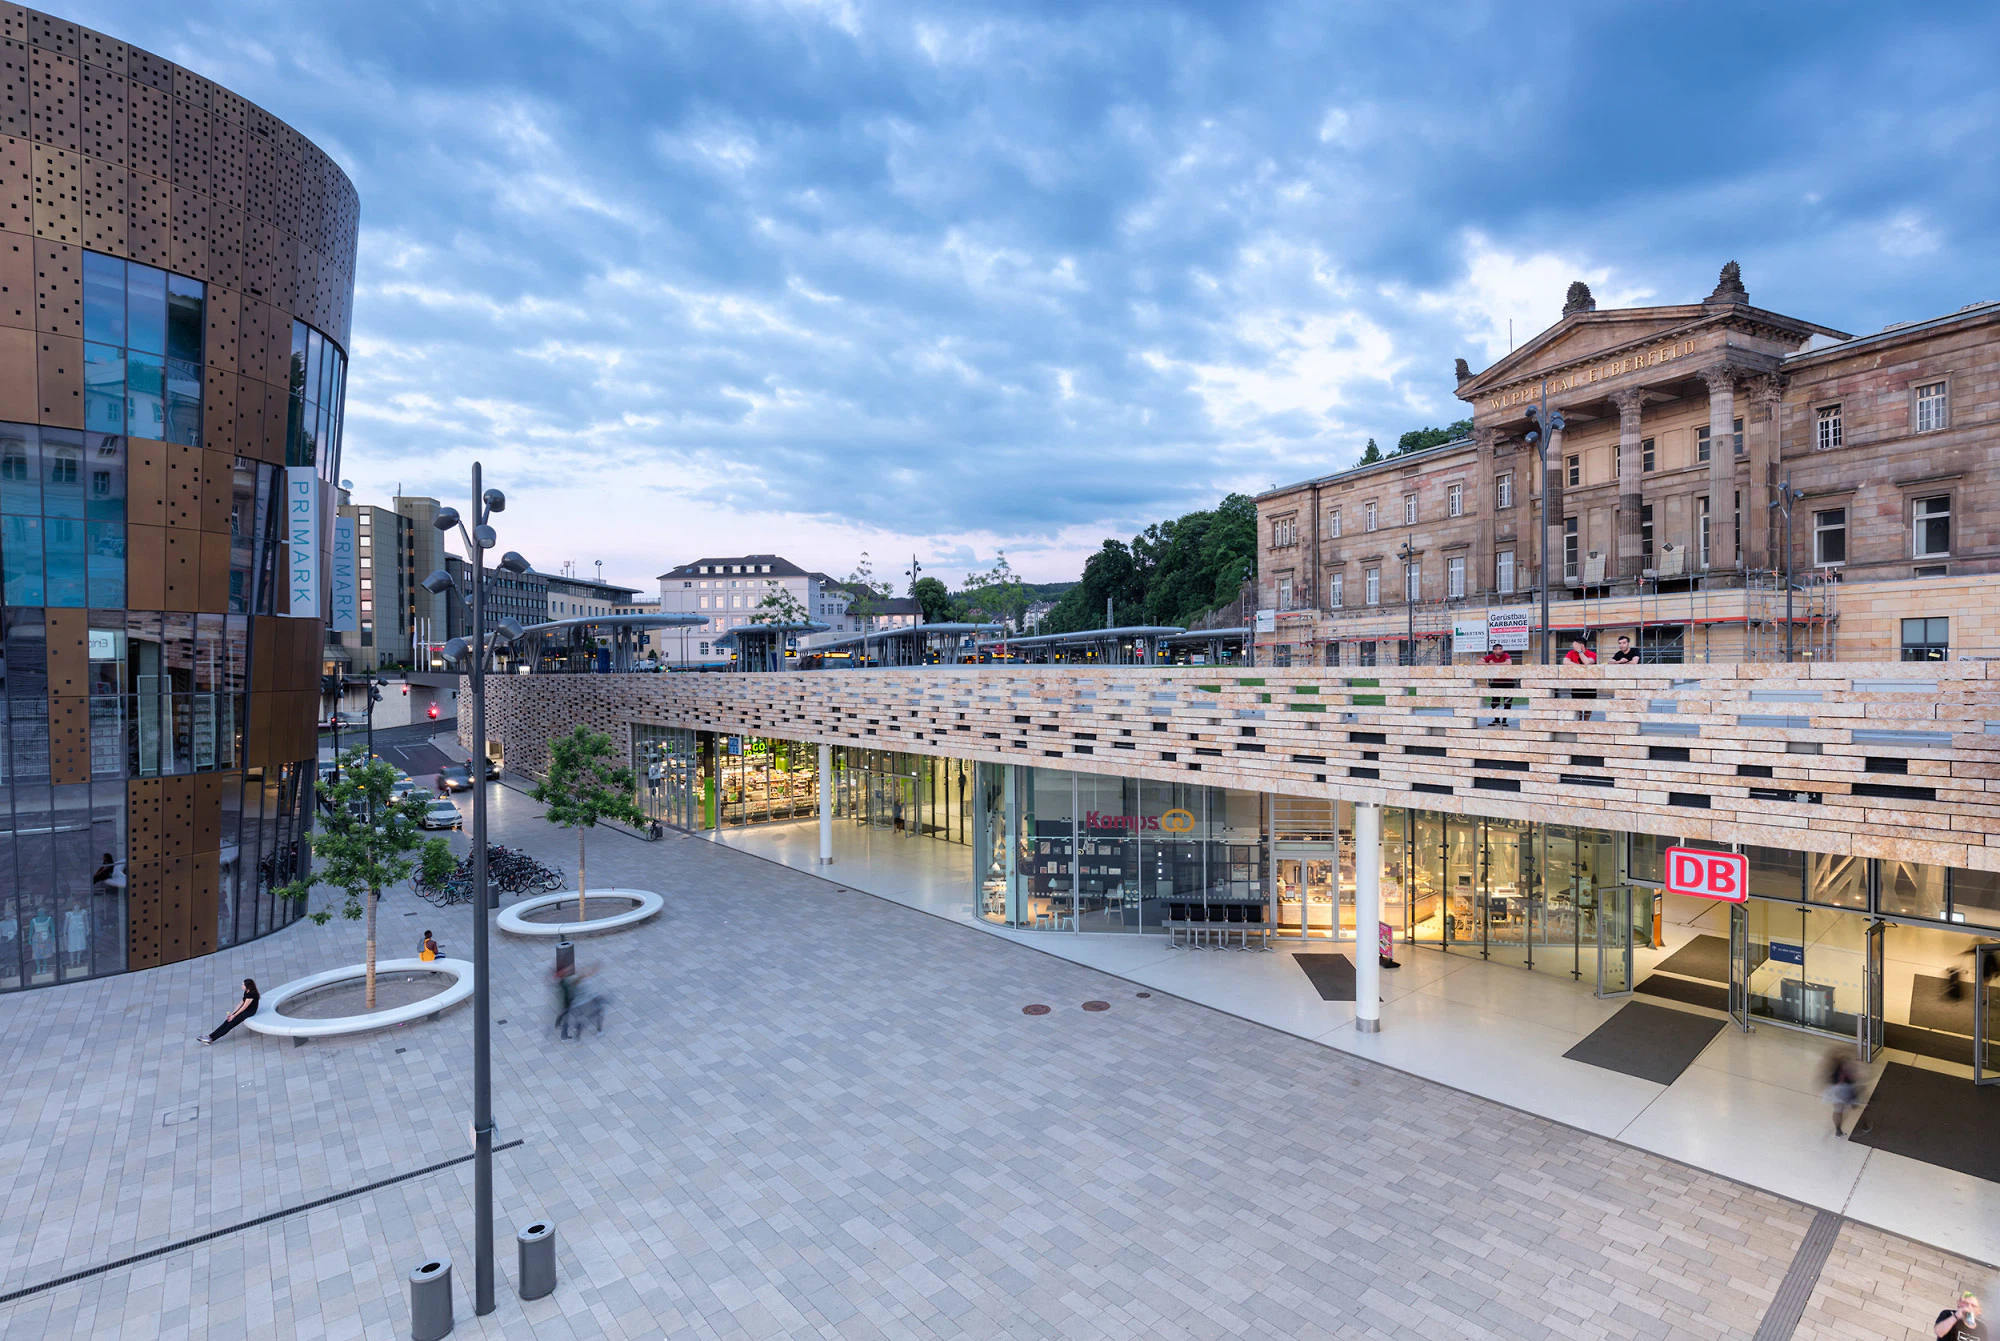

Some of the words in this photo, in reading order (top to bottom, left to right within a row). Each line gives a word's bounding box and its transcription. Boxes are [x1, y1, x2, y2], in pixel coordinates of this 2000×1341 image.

[1589, 340, 1695, 382] ELBERFELD
[292, 481, 311, 602] PRIMARK
[335, 527, 353, 620] PRIMARK
[1490, 613, 1526, 621] Gerüstbau
[642, 635, 649, 644] 5
[752, 742, 766, 751] GO
[1086, 811, 1159, 834] Kamps
[1676, 855, 1736, 893] DB
